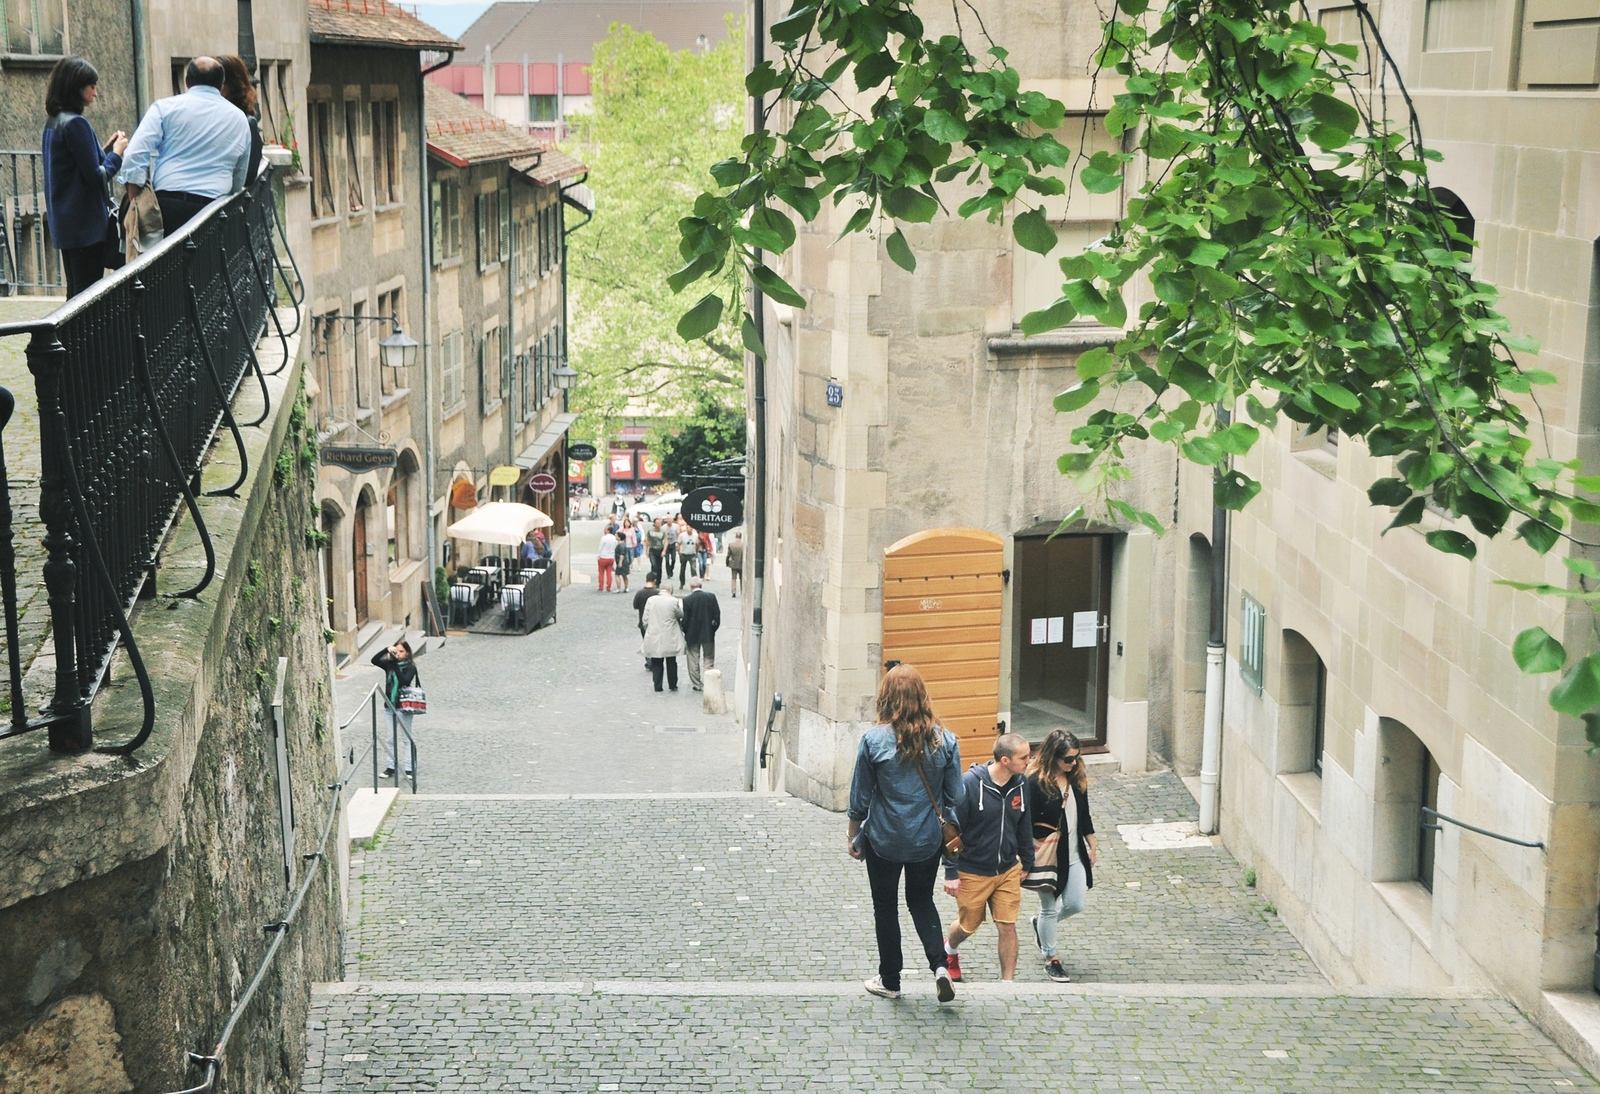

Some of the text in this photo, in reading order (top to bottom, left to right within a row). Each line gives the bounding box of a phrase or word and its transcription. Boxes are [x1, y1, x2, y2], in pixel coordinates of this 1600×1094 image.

[327, 451, 393, 464] Richard Geyer
[690, 513, 733, 523] HERITAGE
